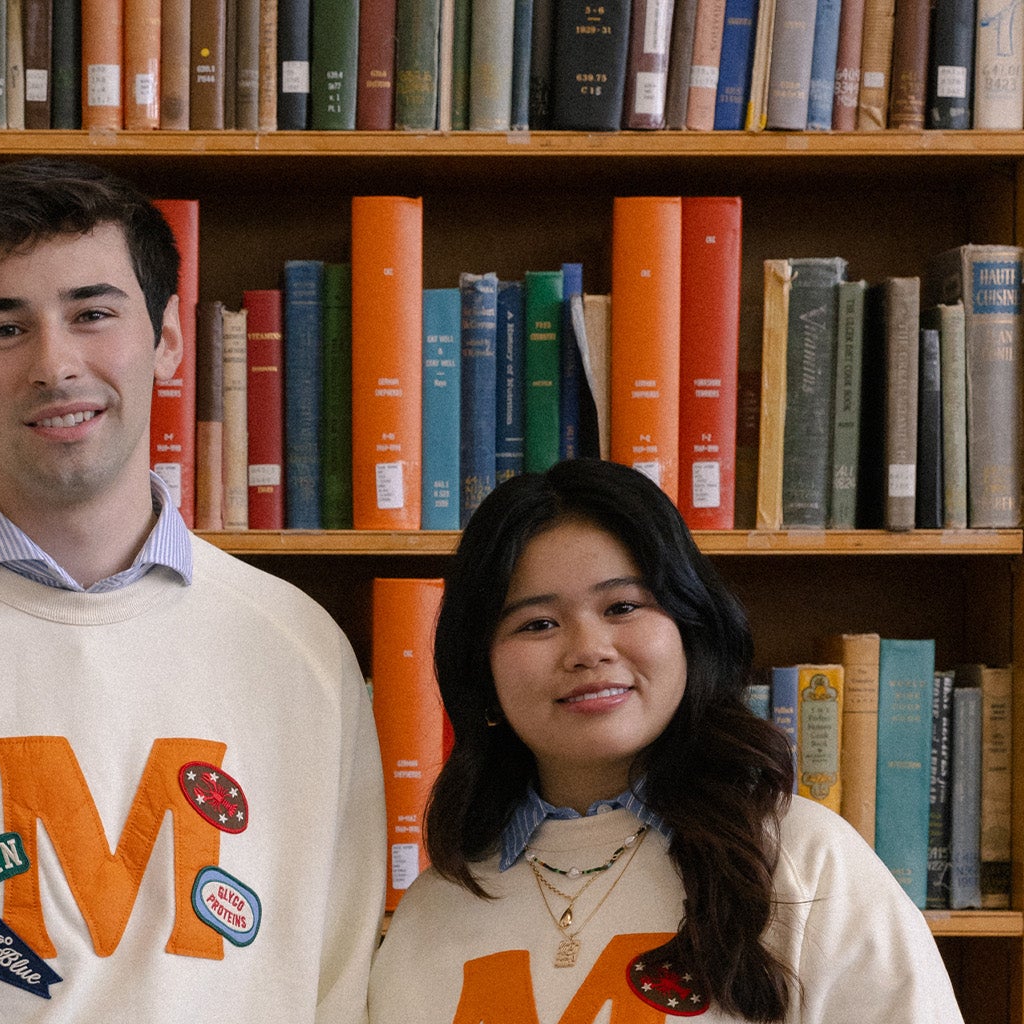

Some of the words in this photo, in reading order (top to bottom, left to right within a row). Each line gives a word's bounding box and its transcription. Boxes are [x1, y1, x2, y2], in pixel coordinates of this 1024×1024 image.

[505, 323, 515, 362] History
[799, 305, 827, 394] Vitamins
[506, 364, 515, 375] of
[506, 377, 515, 426] Nutrition
[205, 893, 247, 929] PROTEINS
[216, 885, 246, 911] GLYCO
